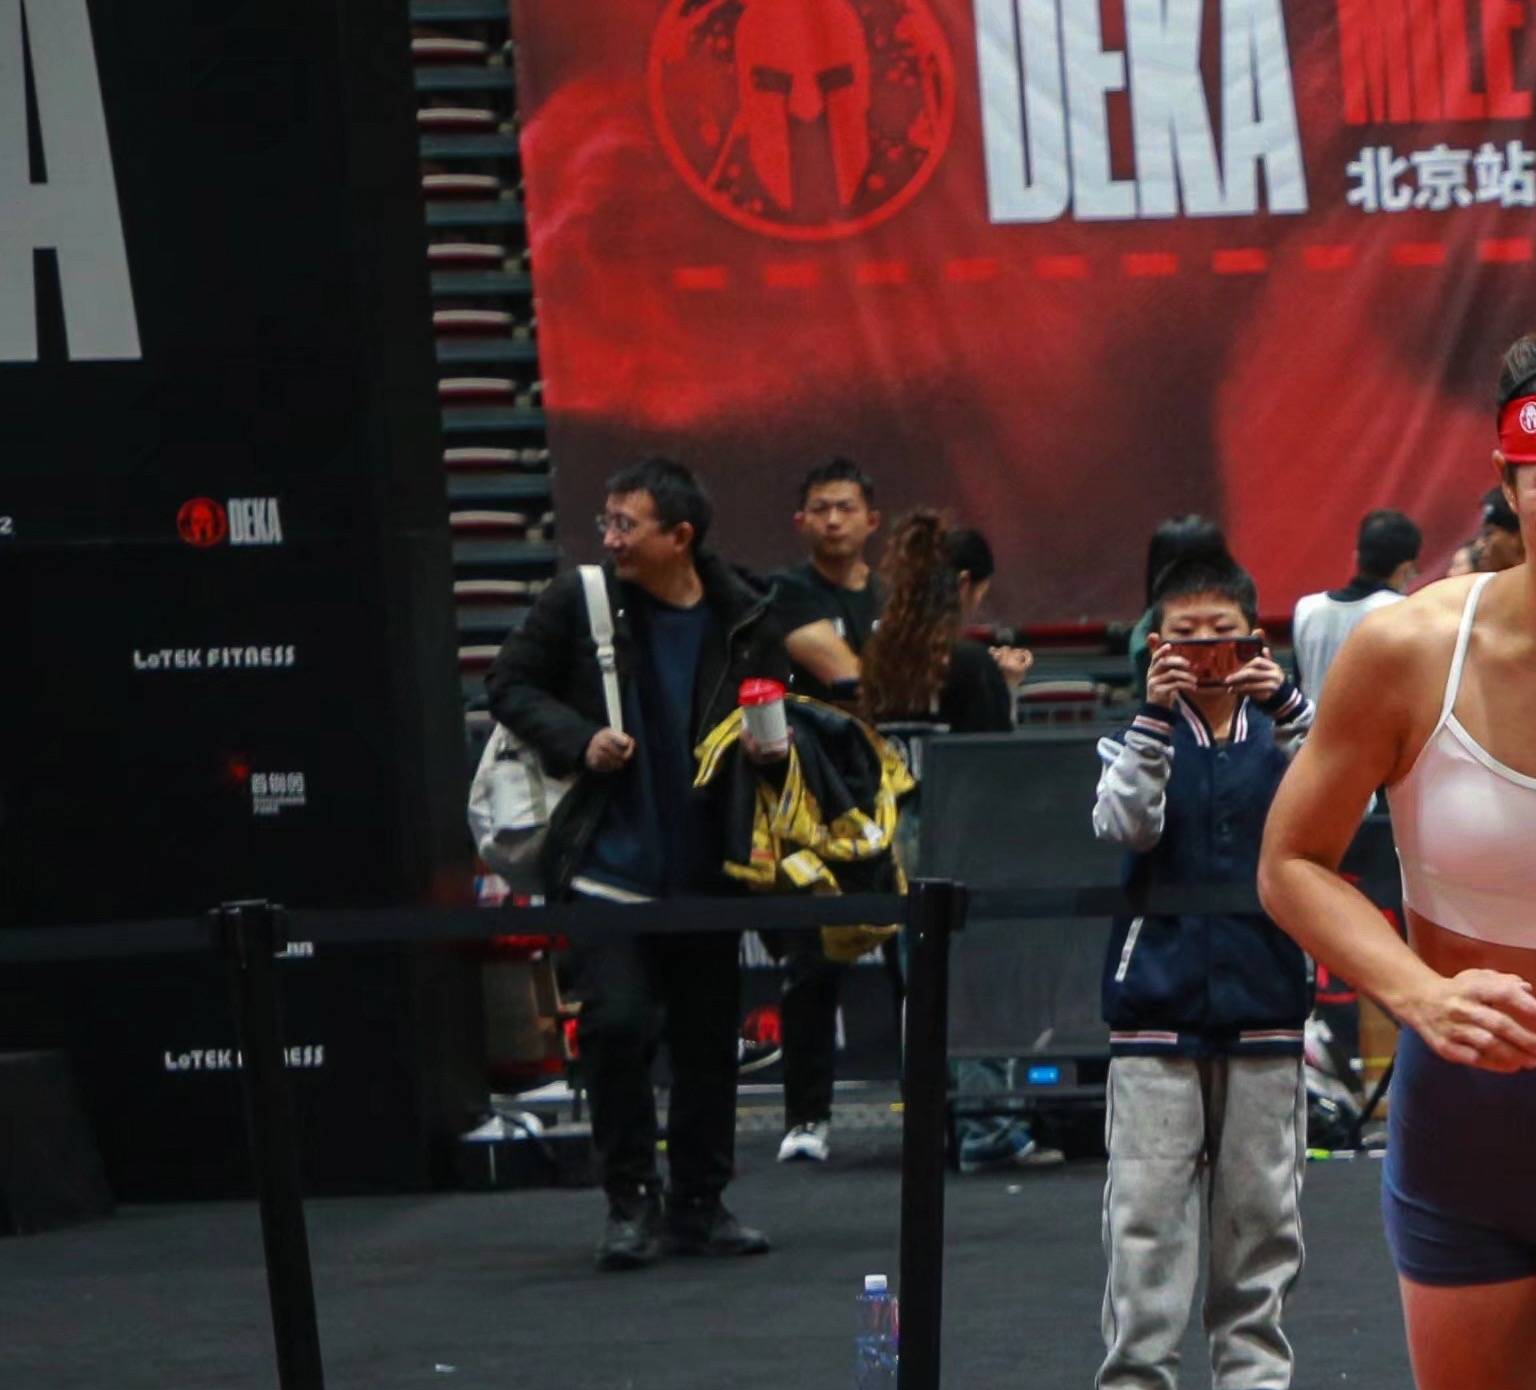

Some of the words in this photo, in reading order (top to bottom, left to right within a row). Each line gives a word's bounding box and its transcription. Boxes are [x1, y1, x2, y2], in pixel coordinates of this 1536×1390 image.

[974, 0, 1308, 224] DEKA
[228, 497, 283, 545] DEKA
[207, 645, 295, 667] FITNESS
